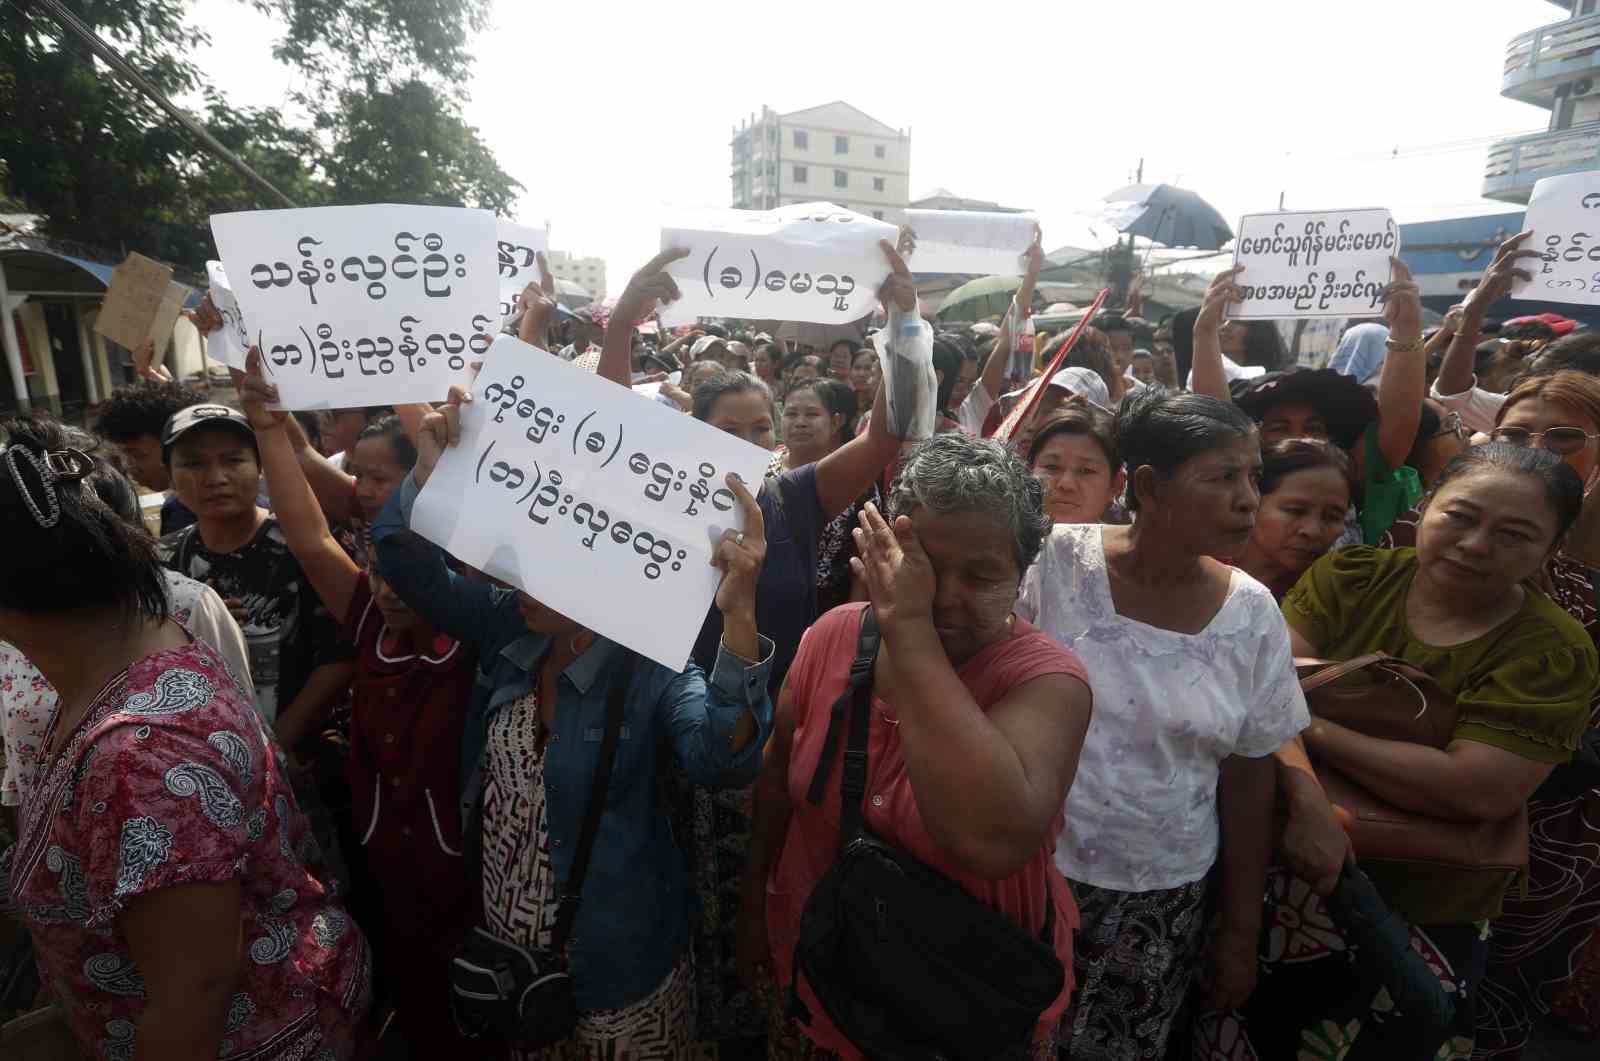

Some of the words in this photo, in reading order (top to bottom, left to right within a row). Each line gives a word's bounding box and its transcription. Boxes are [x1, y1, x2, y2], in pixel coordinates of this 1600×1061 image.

[251, 231, 466, 304] သန်းလွင်ဦး
[485, 375, 566, 444] ကိုဌေး
